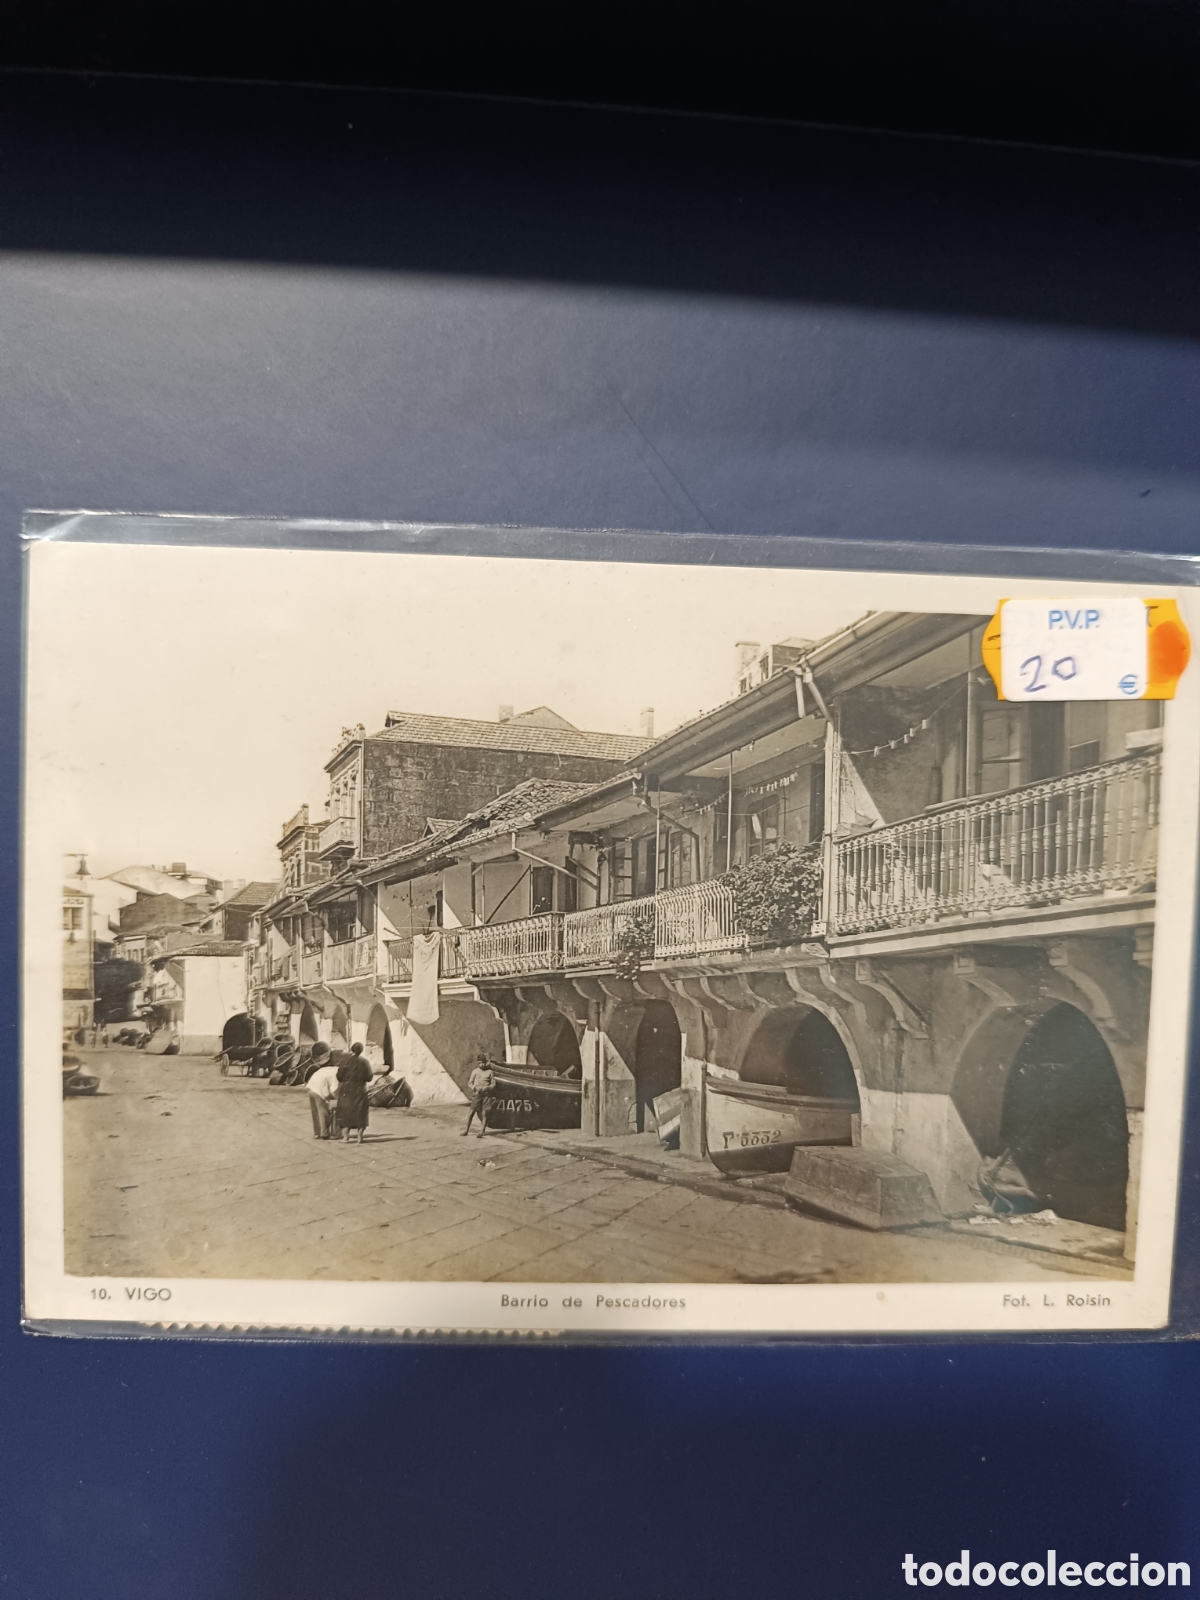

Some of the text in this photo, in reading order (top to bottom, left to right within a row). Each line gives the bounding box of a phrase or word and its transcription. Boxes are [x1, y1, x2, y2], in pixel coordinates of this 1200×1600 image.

[1019, 654, 1078, 693] 20
[90, 1286, 172, 1302] 10. VIGO
[500, 1293, 686, 1309] Barrio de Pescadores
[1002, 1293, 1111, 1308] Fot. L. Roisin
